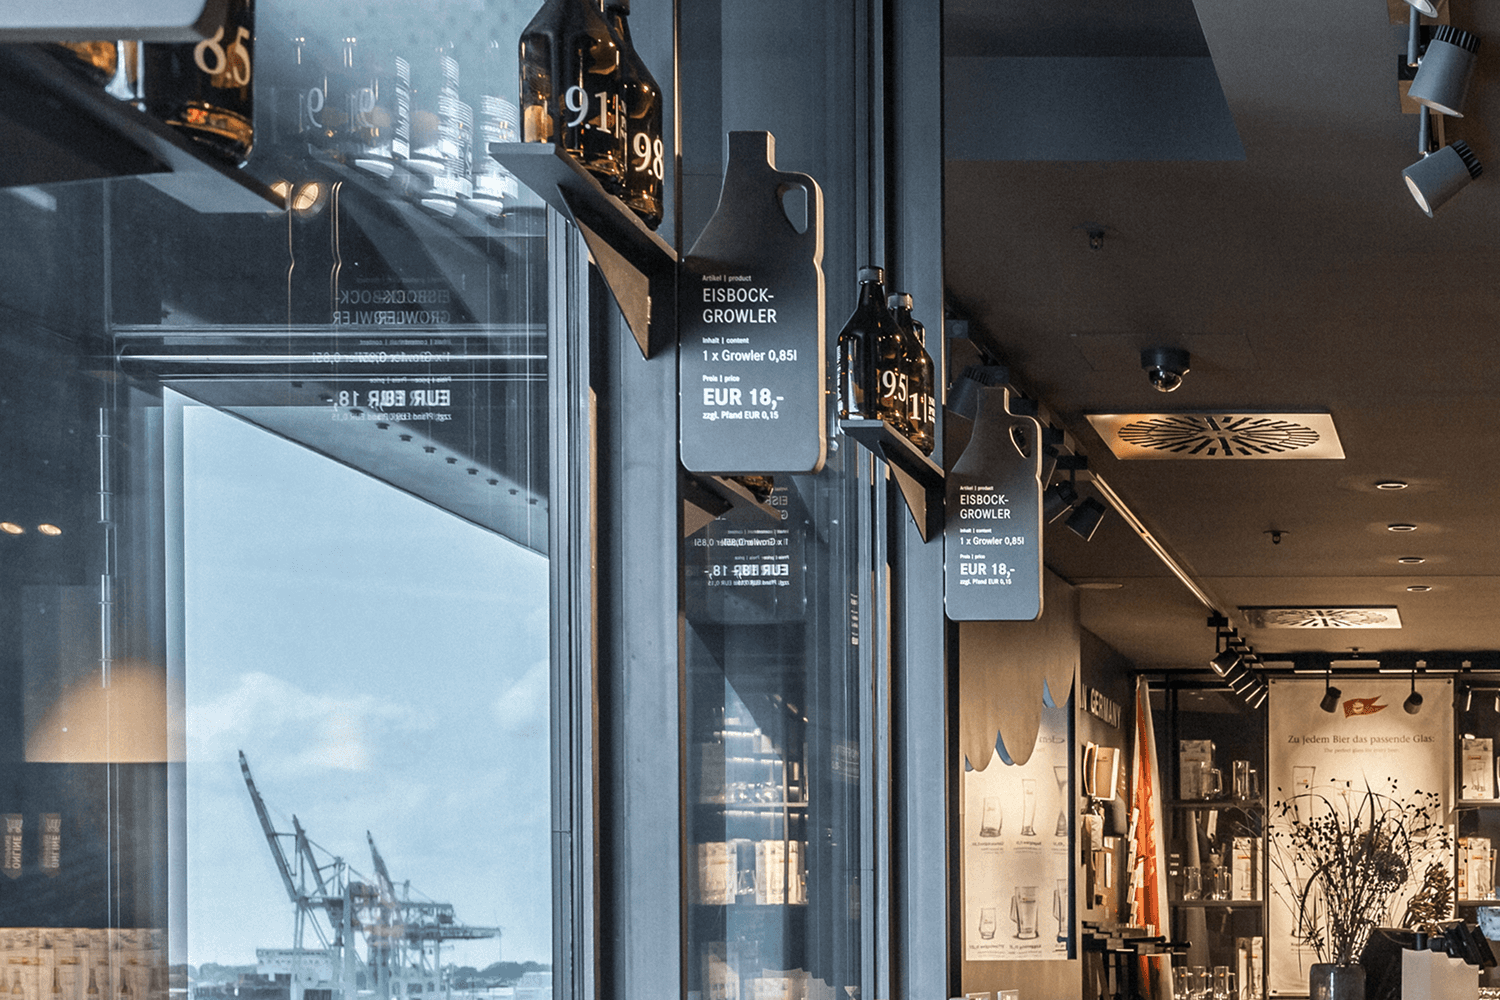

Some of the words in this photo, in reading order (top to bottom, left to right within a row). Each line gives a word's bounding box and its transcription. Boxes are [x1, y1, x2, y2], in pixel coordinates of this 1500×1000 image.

[633, 132, 663, 180] 9.8
[703, 287, 774, 302] EISBOCK-
[702, 308, 777, 323] GROWLER
[703, 349, 708, 361] 1
[712, 352, 719, 361] x
[721, 349, 766, 361] Growler
[768, 349, 798, 363] 0,85l
[703, 387, 742, 406] EUR
[749, 387, 784, 411] 18,-
[721, 411, 743, 419] Pfand
[744, 411, 760, 419] EUR
[761, 411, 779, 420] 0,15
[960, 494, 1009, 505] EISBOCK-
[960, 508, 1011, 519] GROWLER
[960, 536, 964, 545] 1
[973, 536, 1003, 545] Growler
[960, 562, 987, 575] EUR
[992, 562, 1016, 578] 18,-
[1288, 735, 1300, 743] Zu
[1302, 735, 1330, 745] jedem
[1333, 735, 1350, 743] Bier
[1352, 735, 1368, 743] das
[1370, 735, 1411, 745] passende
[1412, 734, 1435, 743] Glas:
